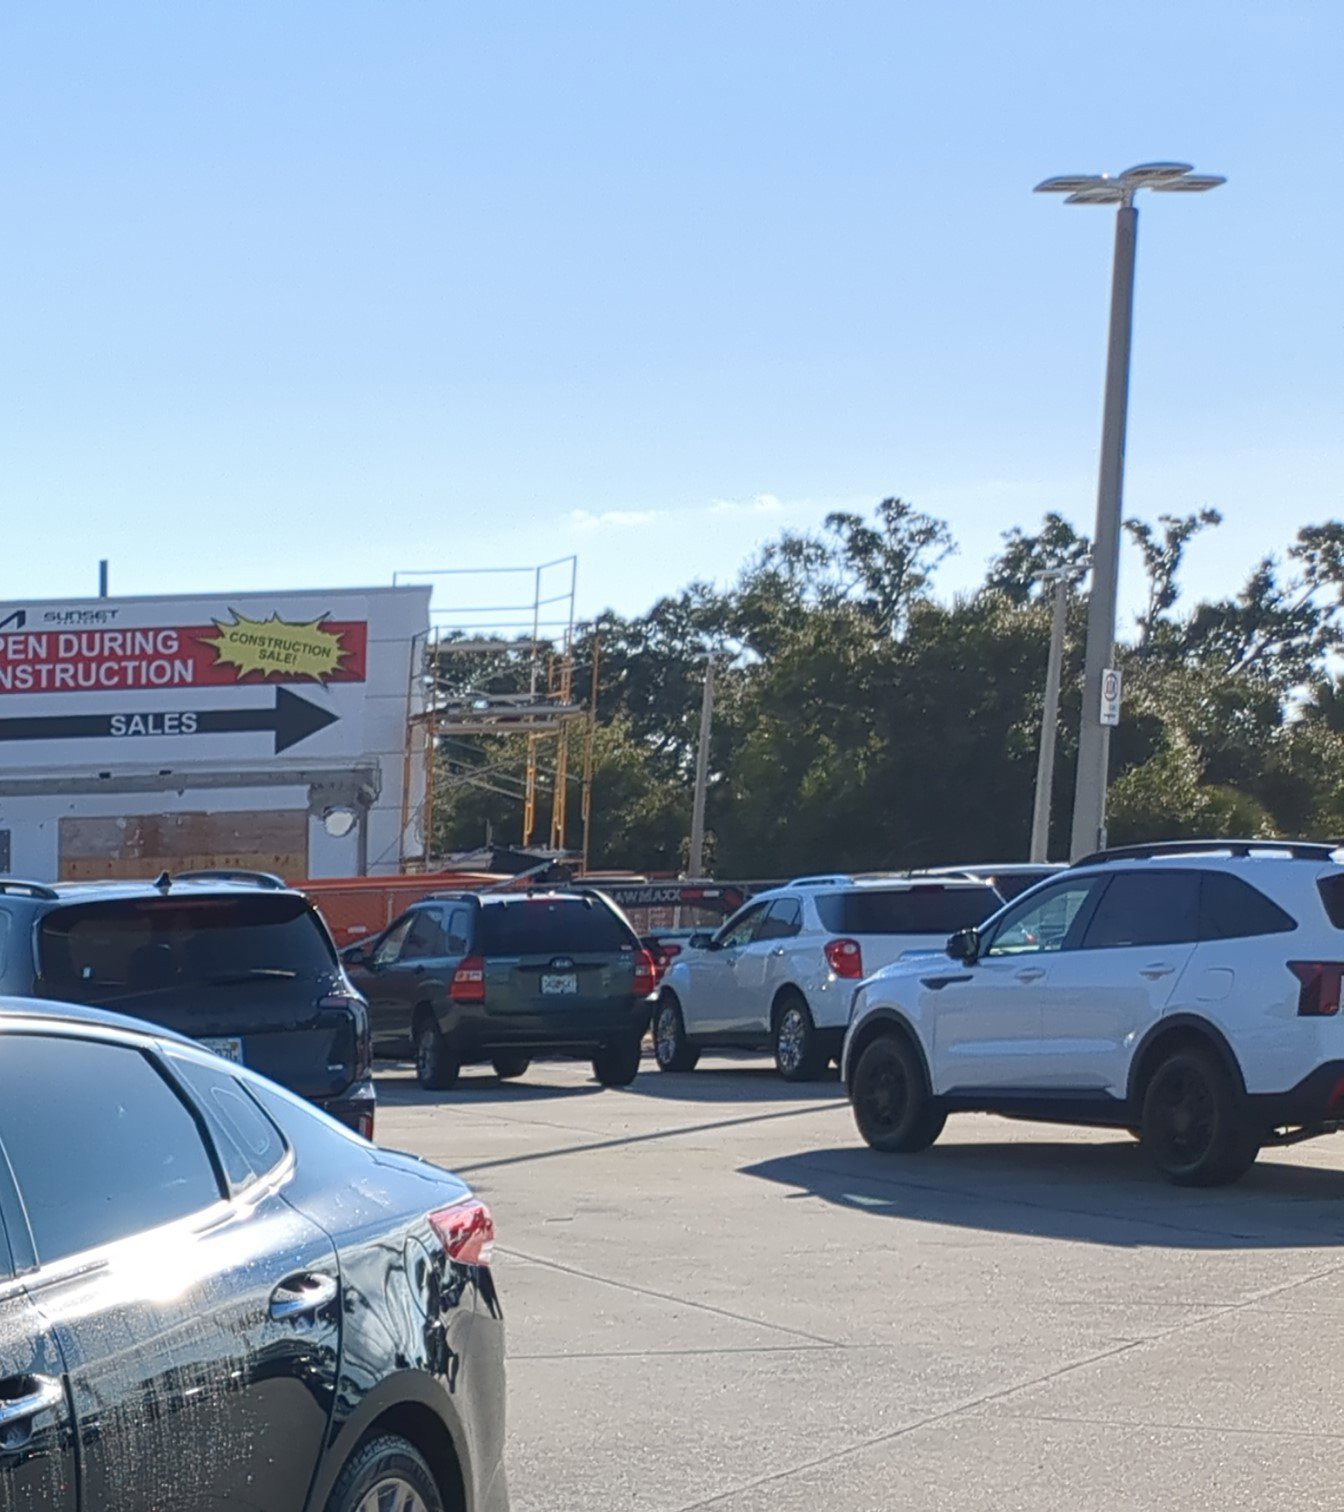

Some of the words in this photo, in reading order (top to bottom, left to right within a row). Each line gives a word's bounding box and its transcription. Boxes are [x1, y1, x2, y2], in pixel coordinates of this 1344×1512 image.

[58, 631, 180, 658] DURING
[228, 631, 332, 659] CONSTRUCTION
[257, 649, 298, 666] SALE!
[110, 712, 198, 736] SALES
